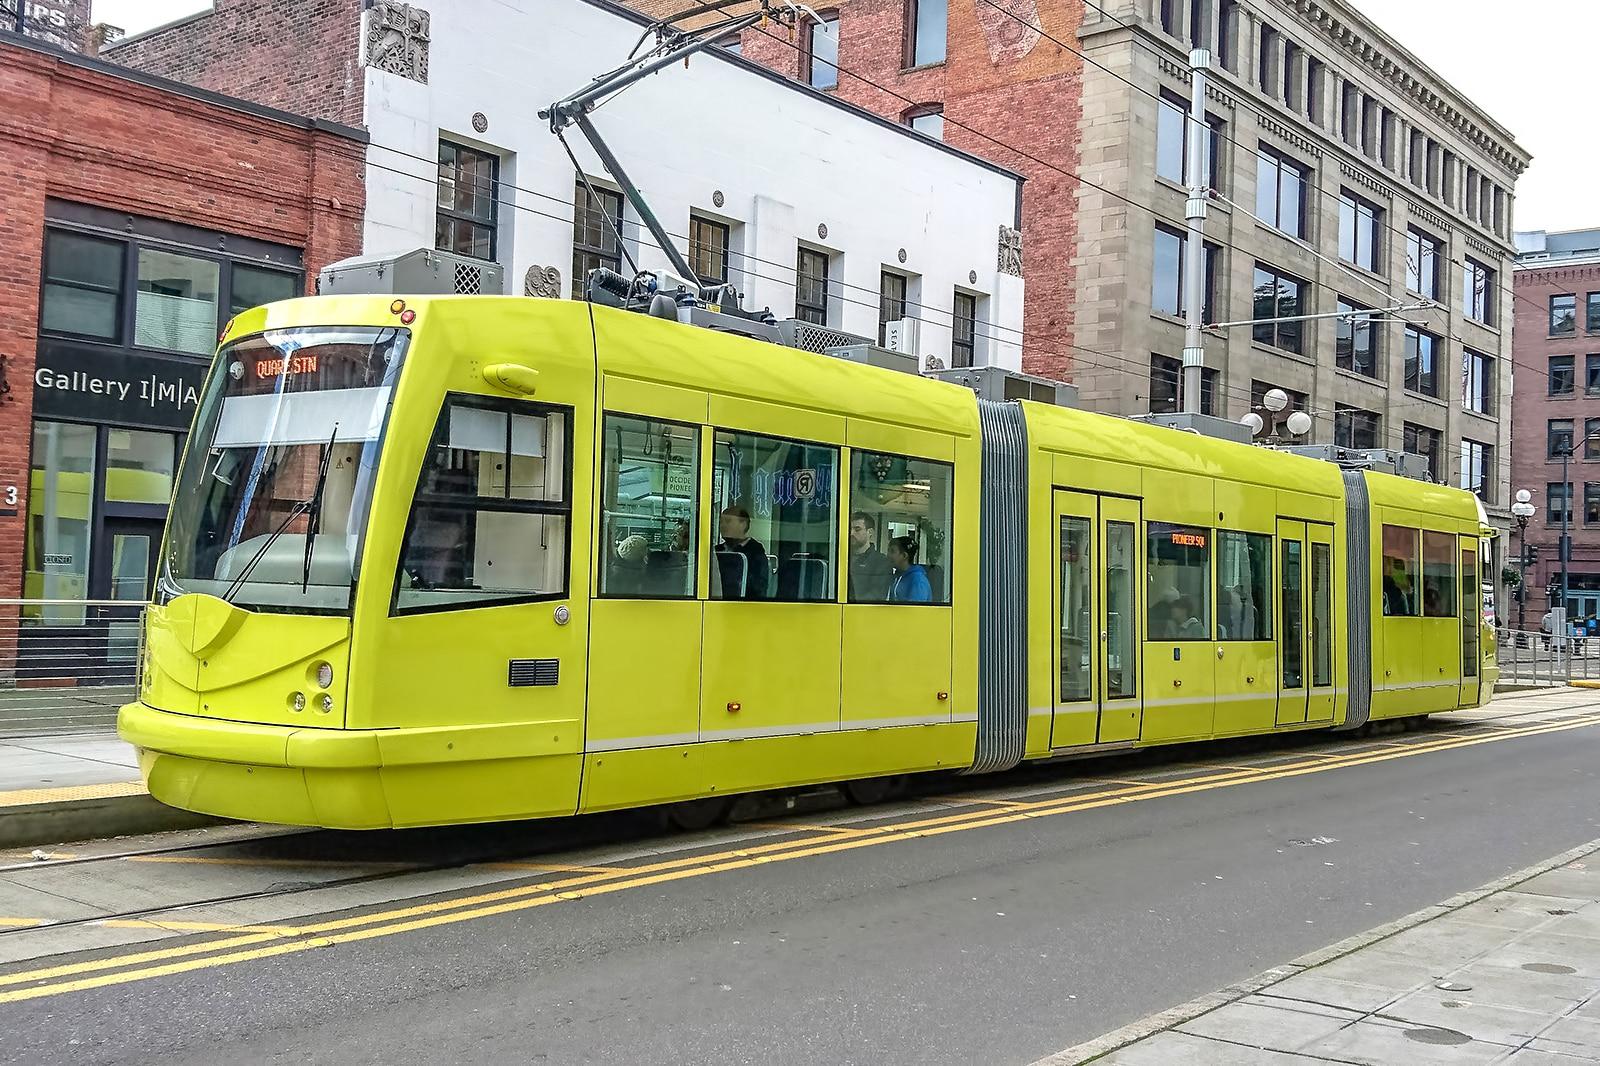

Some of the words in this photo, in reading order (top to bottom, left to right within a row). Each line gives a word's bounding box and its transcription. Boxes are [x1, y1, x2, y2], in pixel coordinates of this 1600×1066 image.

[293, 356, 317, 374] STN
[35, 368, 131, 401] Gallery
[5, 486, 17, 505] 3
[1172, 533, 1196, 546] PIONEER
